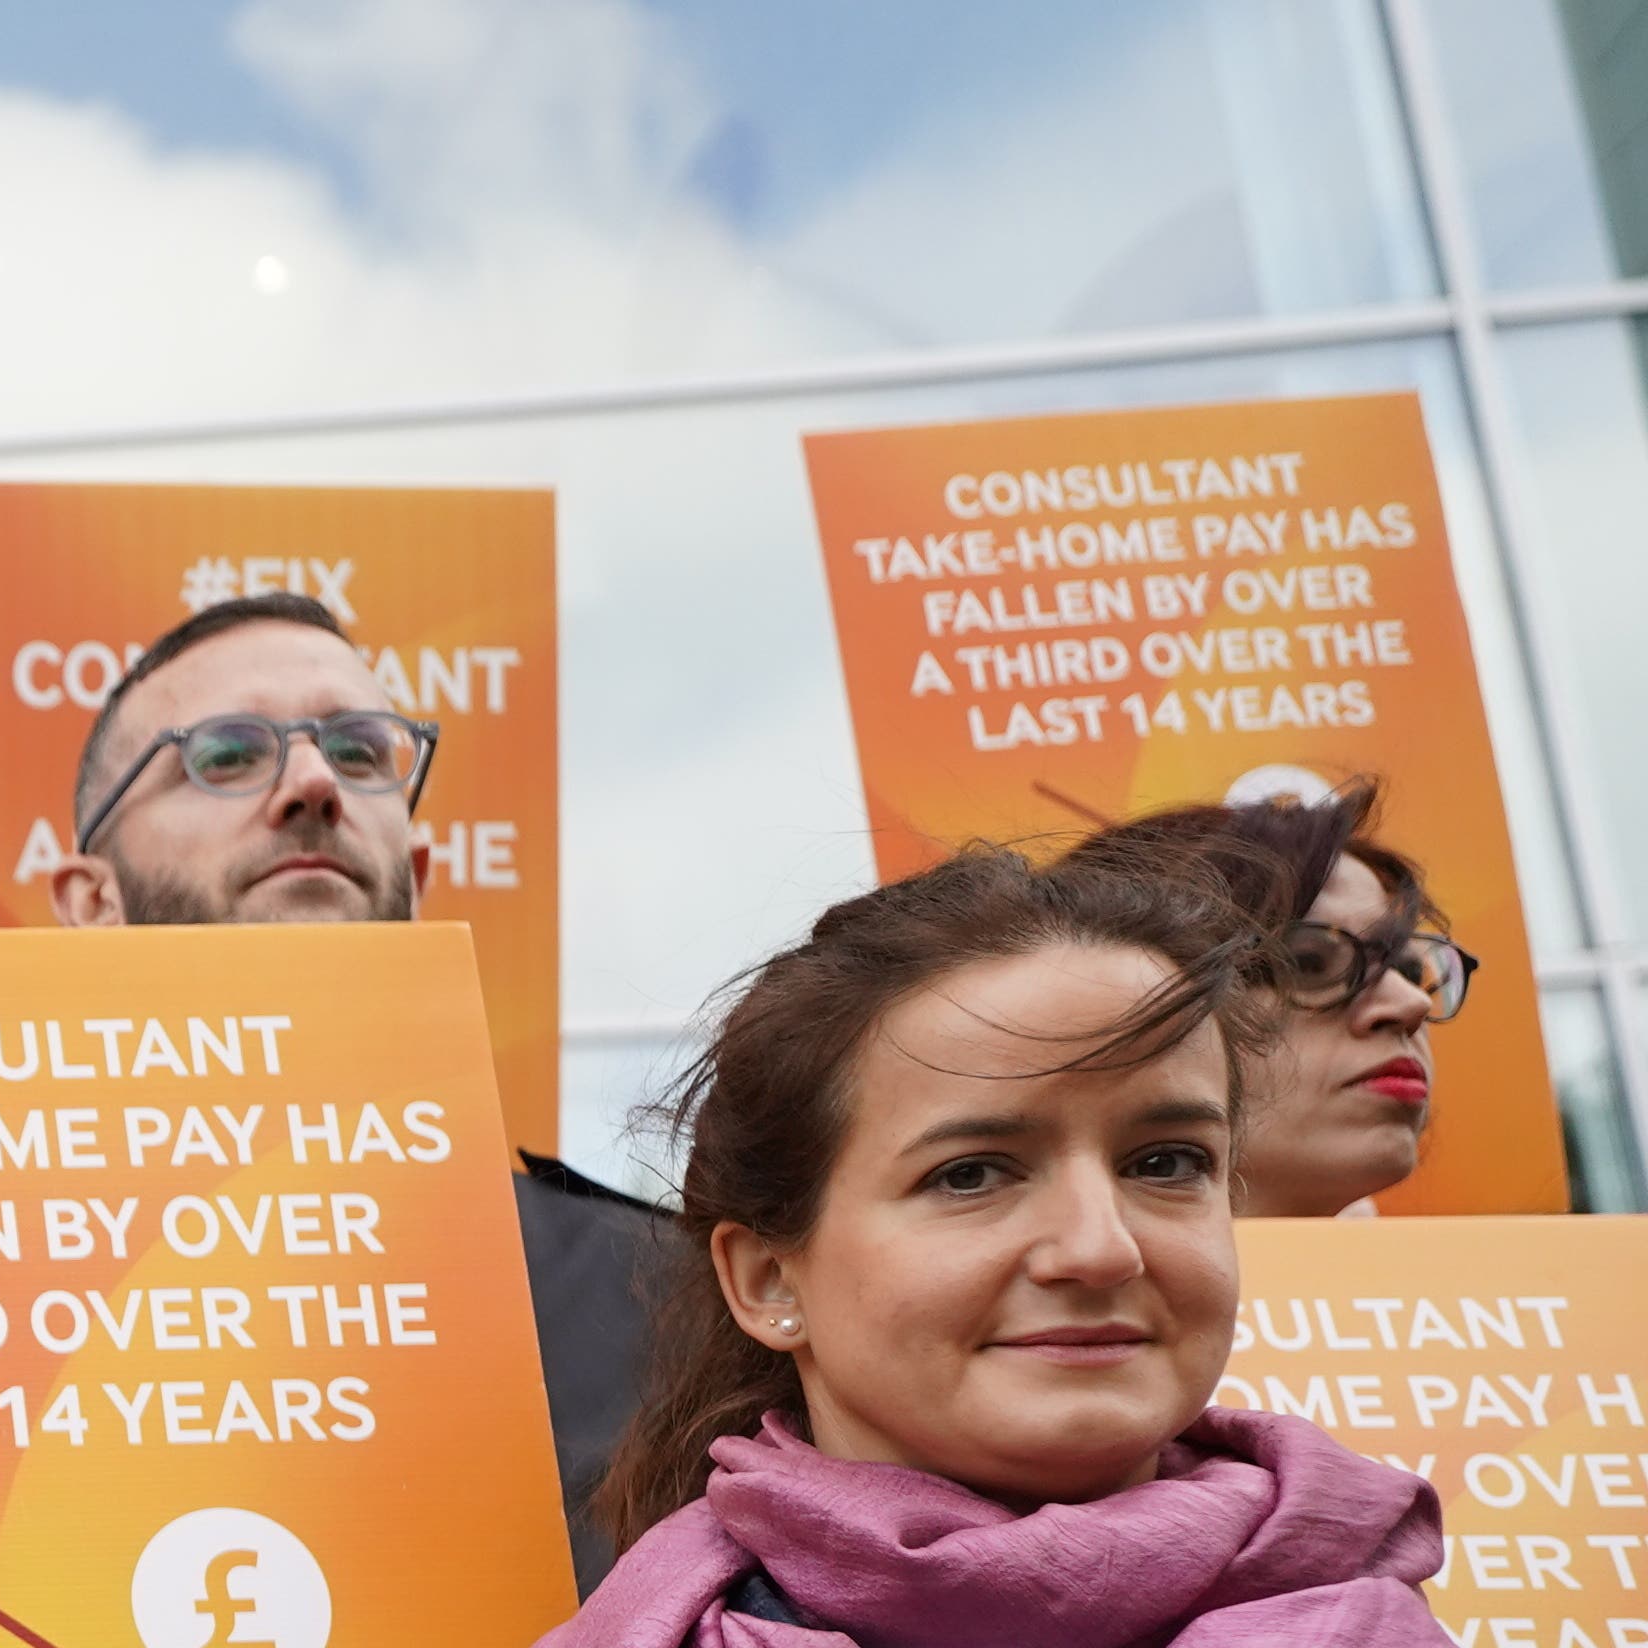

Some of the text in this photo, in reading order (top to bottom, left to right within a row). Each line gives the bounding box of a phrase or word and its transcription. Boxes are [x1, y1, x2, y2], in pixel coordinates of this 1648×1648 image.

[945, 452, 1305, 518] CONSULTANT
[854, 504, 1417, 584] TAKE-HOME PAY HAS
[923, 564, 1375, 637] FALLEN BY OVER
[910, 619, 1412, 696] A THIRD OVER THE
[967, 682, 1375, 751] LAST 14 YEARS
[126, 1104, 264, 1168] PAY
[288, 1100, 451, 1165] HAS
[45, 1196, 138, 1259] BY
[161, 1192, 385, 1257] OVER
[30, 1288, 255, 1354] OVER
[269, 1282, 436, 1347] THE
[103, 1377, 376, 1444] YEARS
[1407, 1373, 1553, 1429] PAY
[1464, 1453, 1648, 1509] OVE
